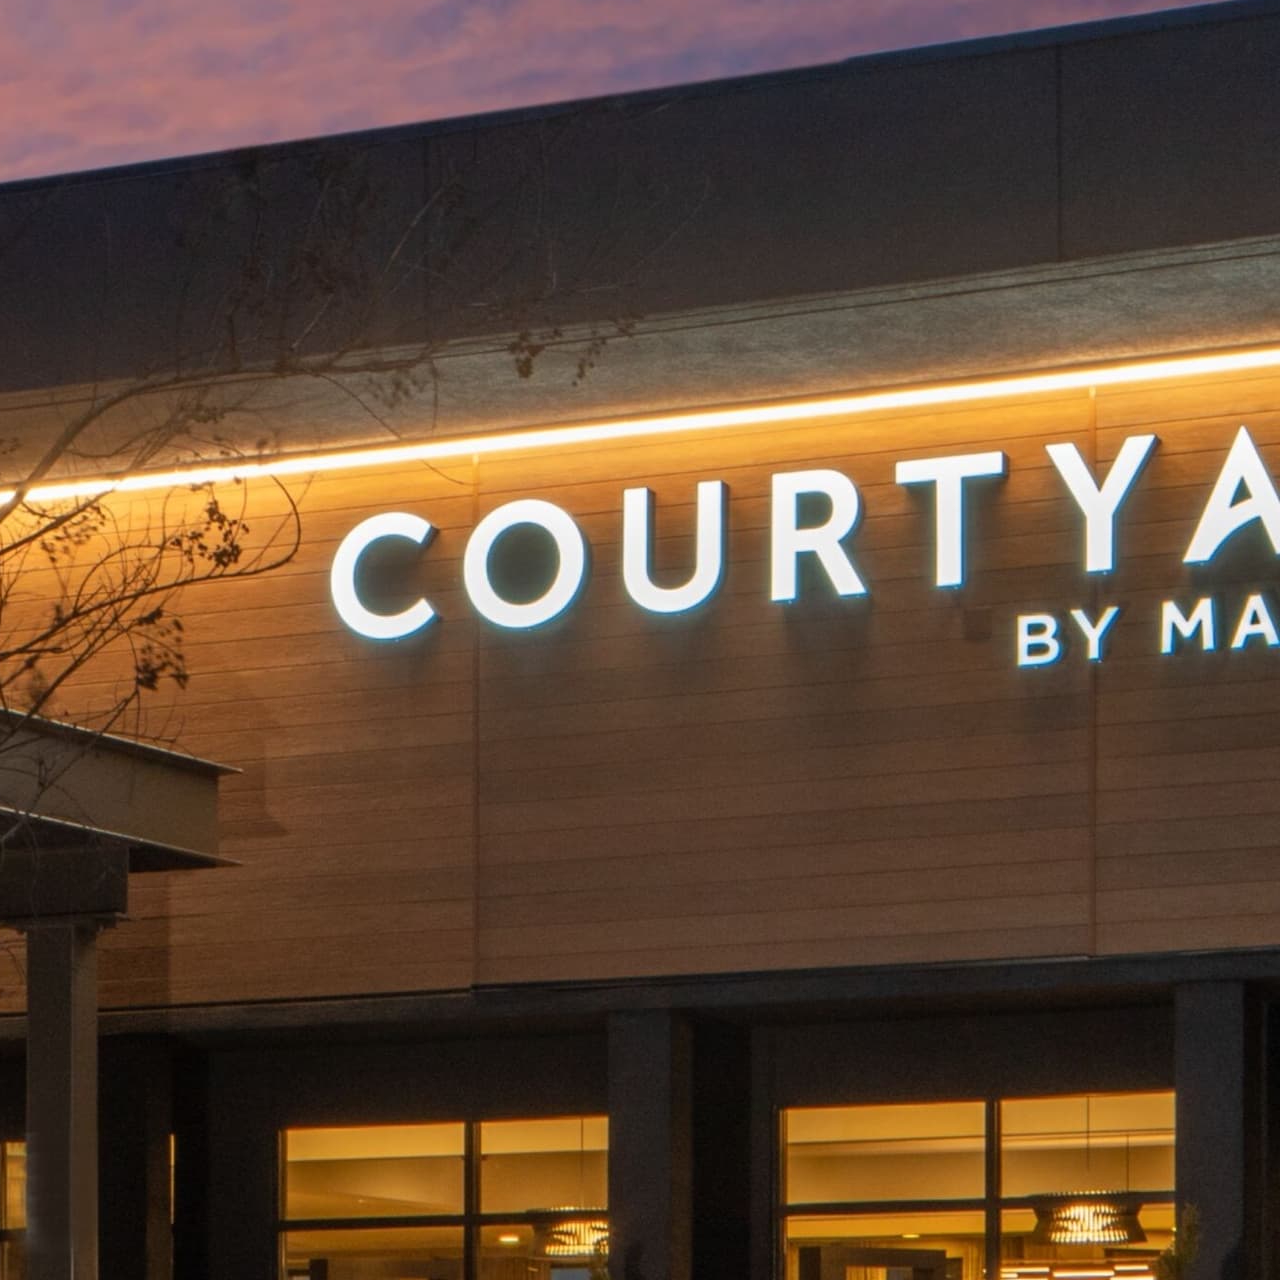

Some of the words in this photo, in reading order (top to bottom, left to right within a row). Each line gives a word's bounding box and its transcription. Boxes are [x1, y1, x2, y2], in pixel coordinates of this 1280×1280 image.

[330, 425, 1280, 641] COURTYA
[1017, 605, 1121, 668] BY
[1160, 593, 1280, 654] MA
